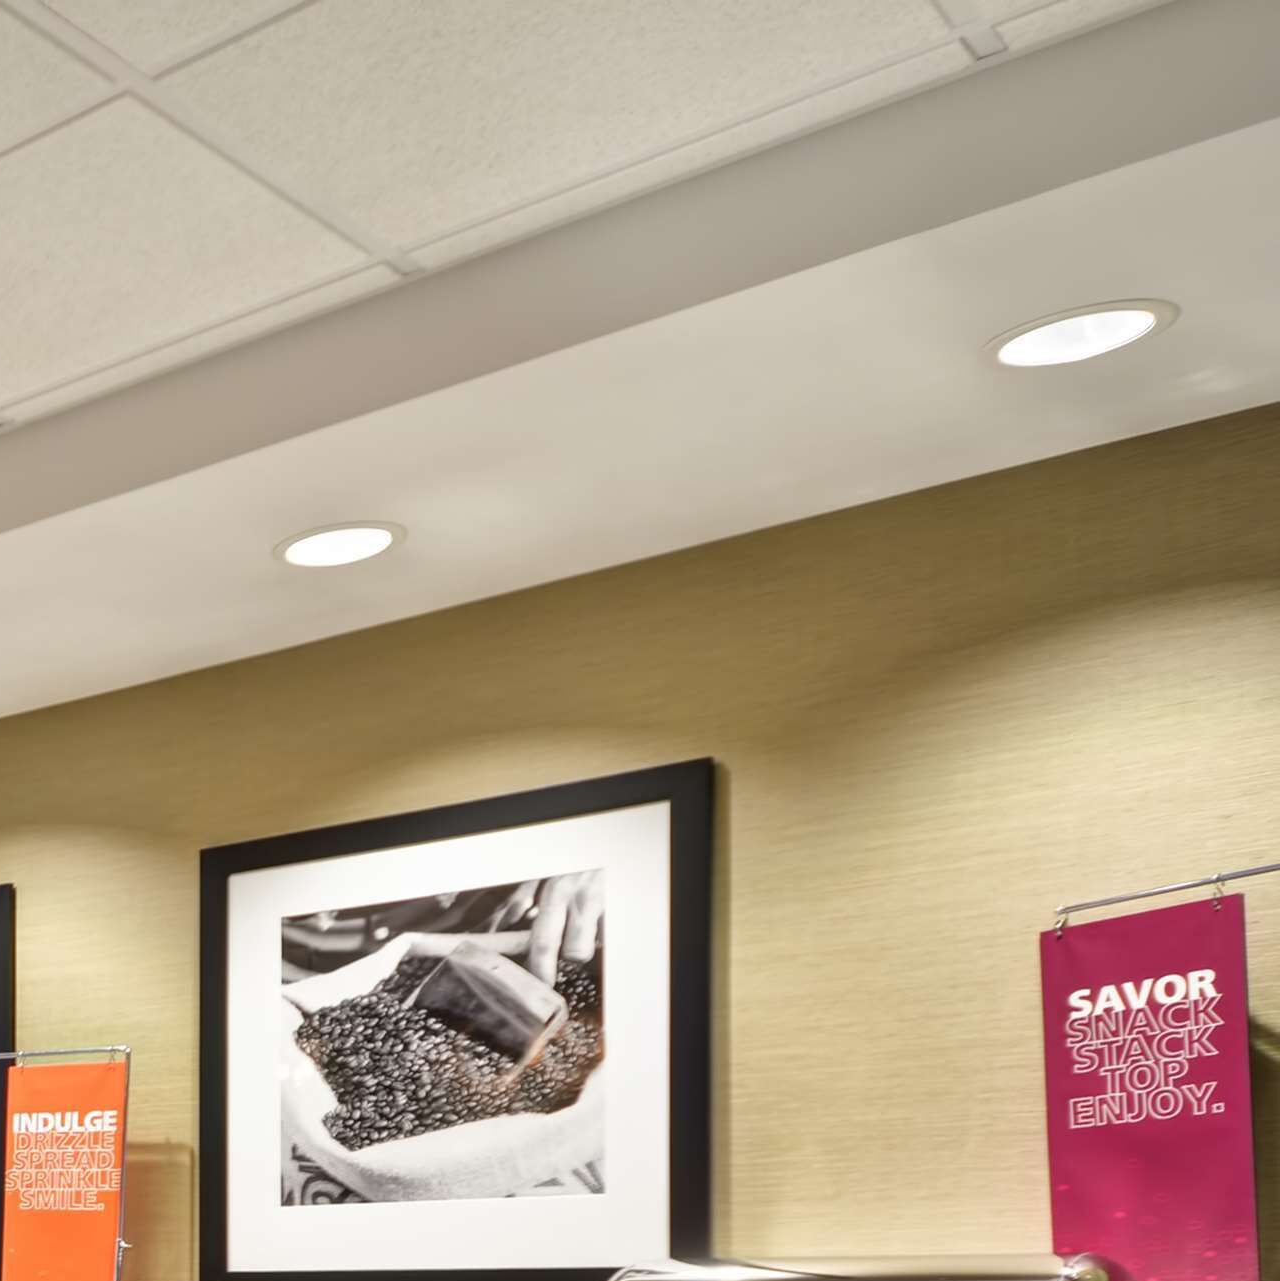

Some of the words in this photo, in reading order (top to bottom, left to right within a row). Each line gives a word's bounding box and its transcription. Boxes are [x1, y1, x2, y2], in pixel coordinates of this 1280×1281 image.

[1068, 968, 1217, 1019] SAVOR
[1066, 994, 1225, 1048] SNACK
[1072, 1025, 1220, 1074] STACK
[1099, 1058, 1189, 1096] TOP
[1069, 1082, 1226, 1129] ENJOY.
[12, 1110, 118, 1133] INDULGE
[15, 1131, 115, 1151] DRIZZLE
[14, 1149, 116, 1170] SPREAD
[5, 1168, 121, 1190] SPRINKLE
[19, 1188, 106, 1211] SMILE.
